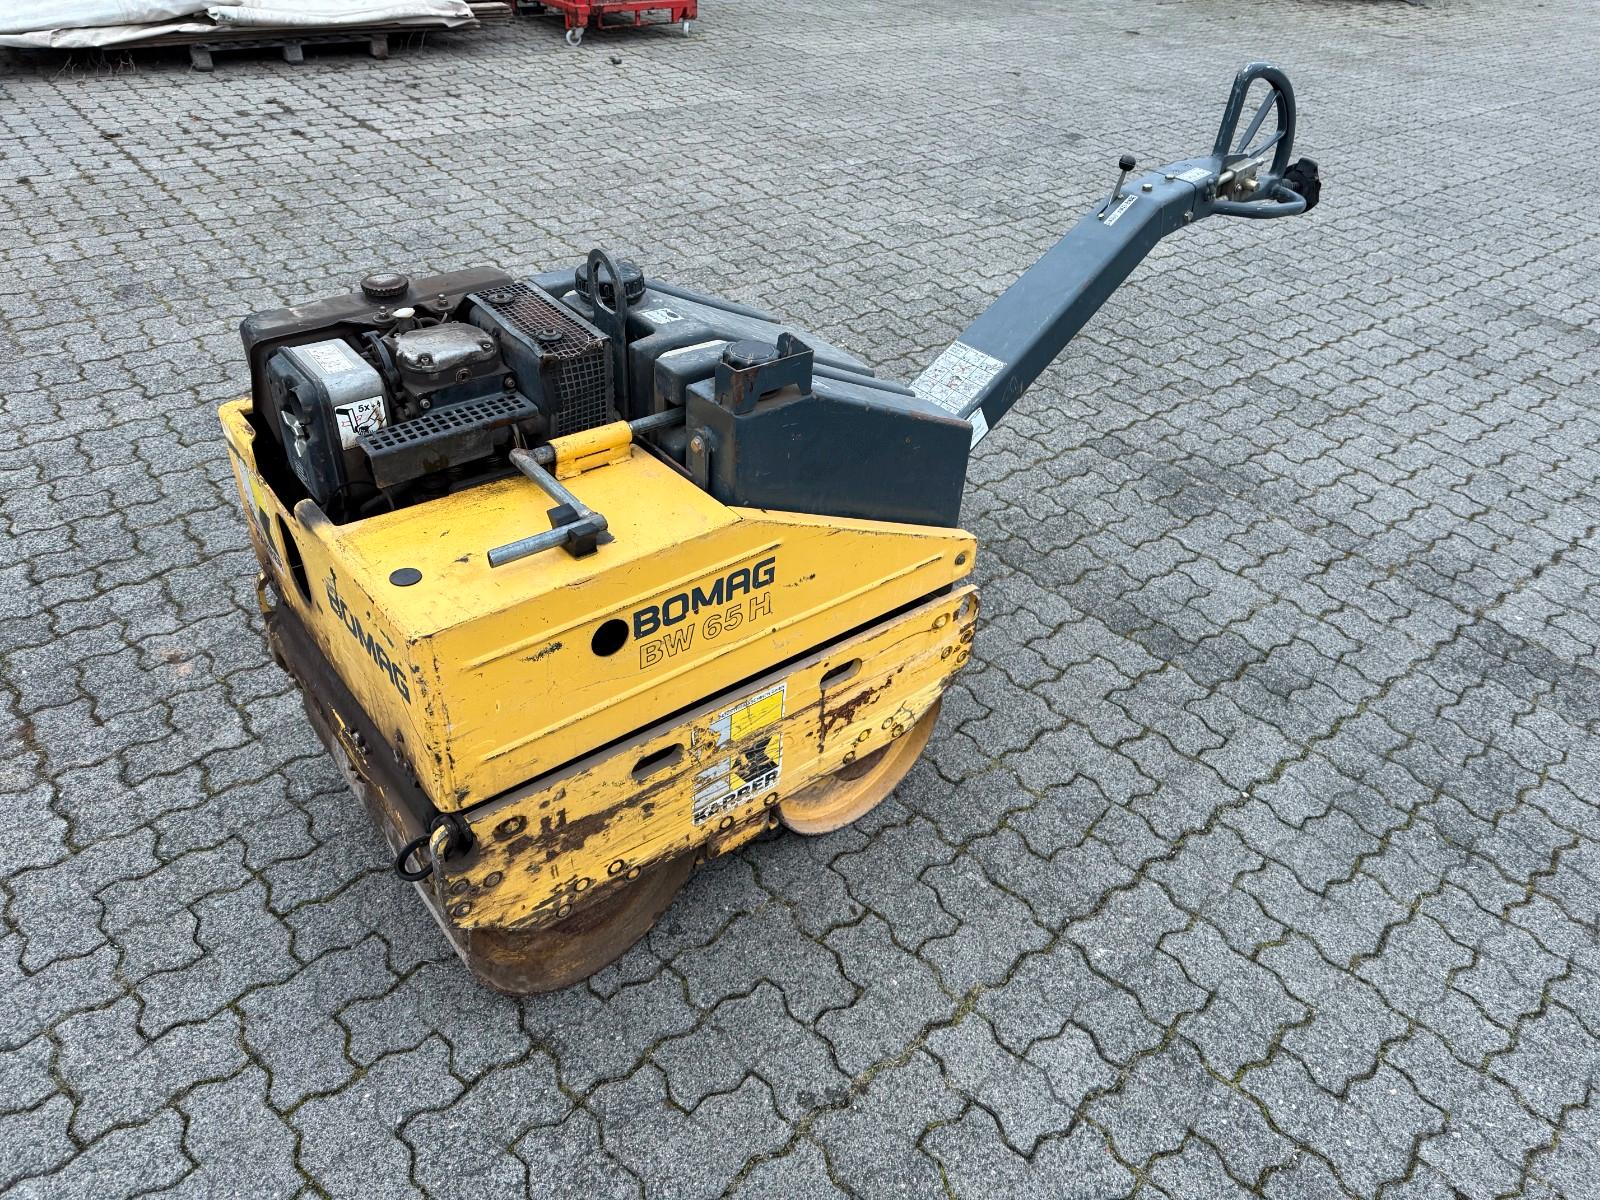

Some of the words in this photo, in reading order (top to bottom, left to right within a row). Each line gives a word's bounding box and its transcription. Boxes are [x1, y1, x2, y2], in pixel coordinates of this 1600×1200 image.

[325, 574, 412, 706] BOMAG
[633, 556, 776, 640] BOMAG
[639, 623, 695, 670] BW
[702, 603, 743, 640] 65
[748, 592, 773, 622] H
